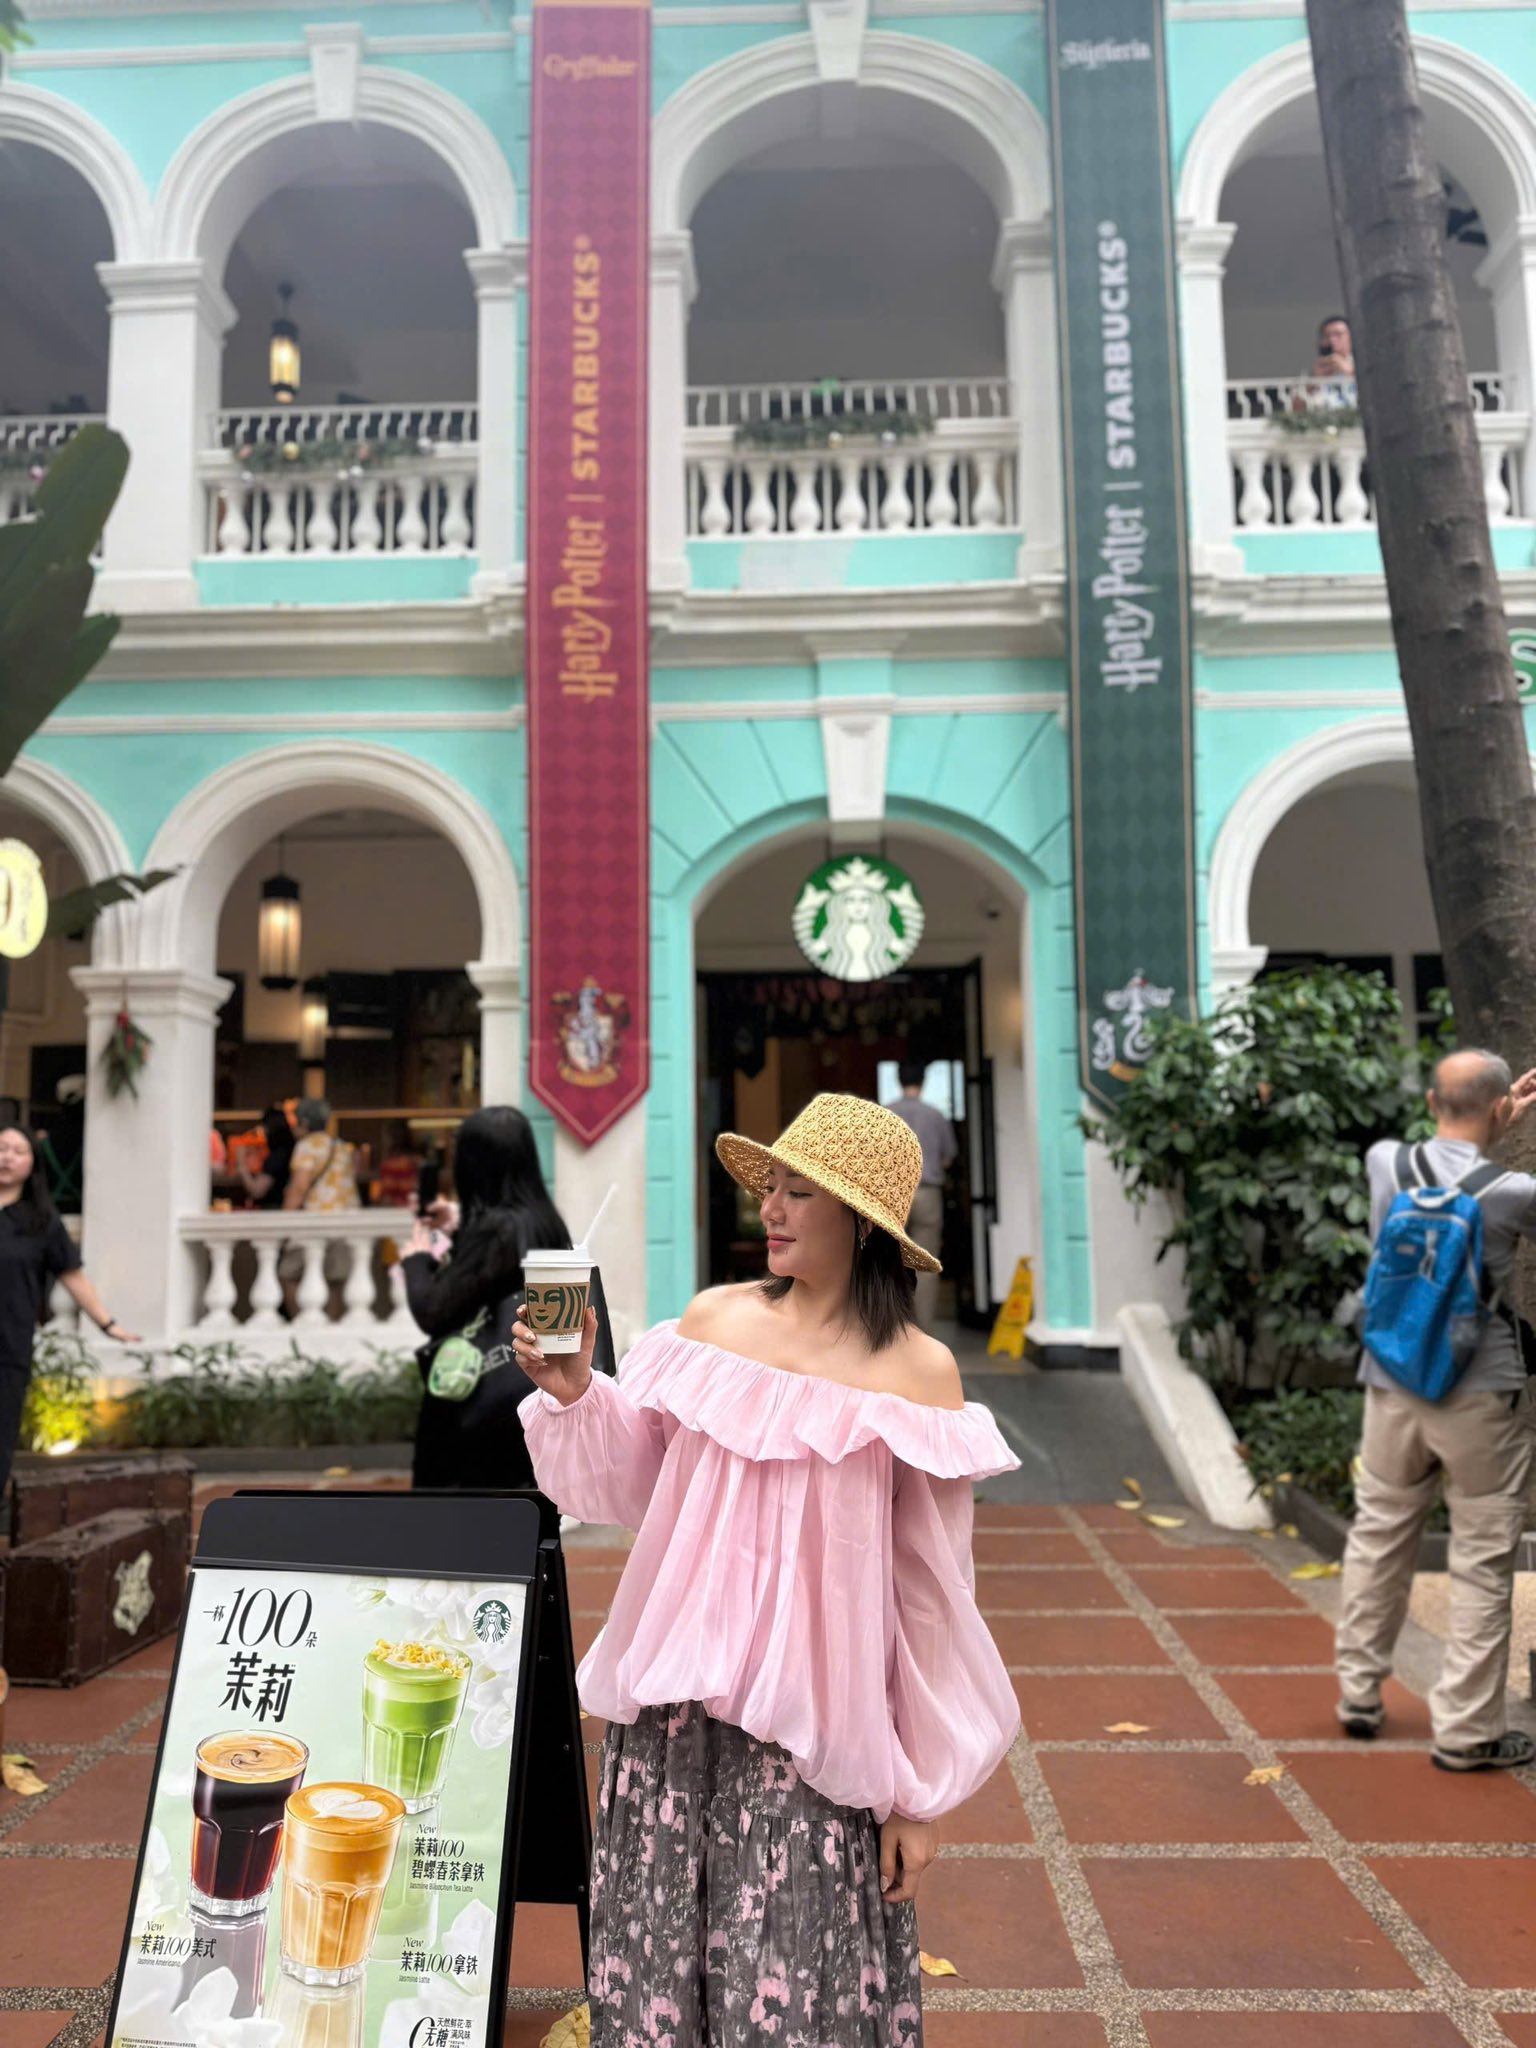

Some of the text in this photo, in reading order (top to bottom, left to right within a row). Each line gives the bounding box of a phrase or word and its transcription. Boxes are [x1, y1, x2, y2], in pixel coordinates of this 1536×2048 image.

[552, 515, 616, 609] Potter
[1092, 504, 1160, 600] Potter
[558, 608, 619, 703] Harry
[1100, 599, 1162, 693] Harry
[216, 1587, 313, 1648] 100
[218, 1651, 296, 1723] 茉莉
[413, 1837, 465, 1858] 茉莉100
[416, 1823, 437, 1834] New
[411, 1859, 485, 1882] 碧螺春茶拿铁
[144, 1920, 164, 1931] New
[403, 1937, 424, 1948] New
